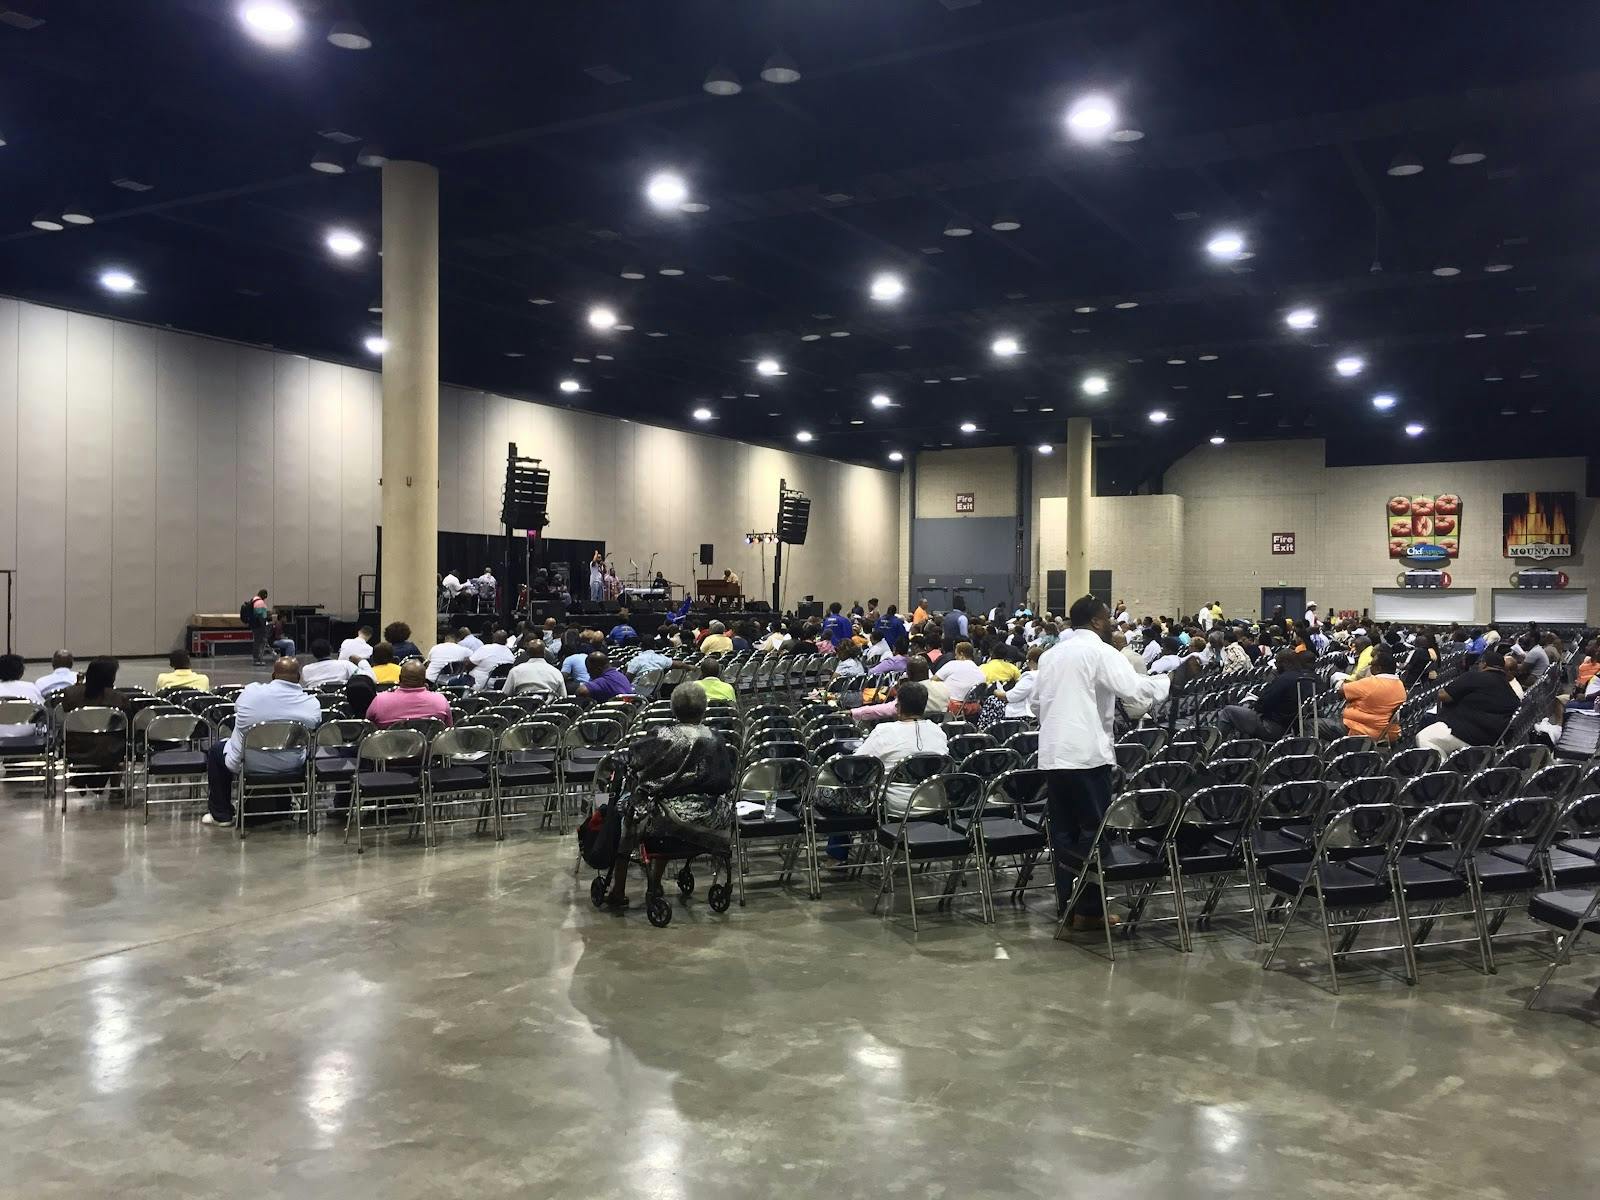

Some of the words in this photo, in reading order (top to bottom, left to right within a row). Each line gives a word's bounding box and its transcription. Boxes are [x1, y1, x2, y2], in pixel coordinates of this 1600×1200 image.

[957, 502, 973, 510] Exit
[1273, 535, 1293, 543] Fire
[1273, 543, 1294, 551] Exit
[1406, 547, 1424, 555] Chef
[1510, 547, 1569, 556] MOUNTAIN
